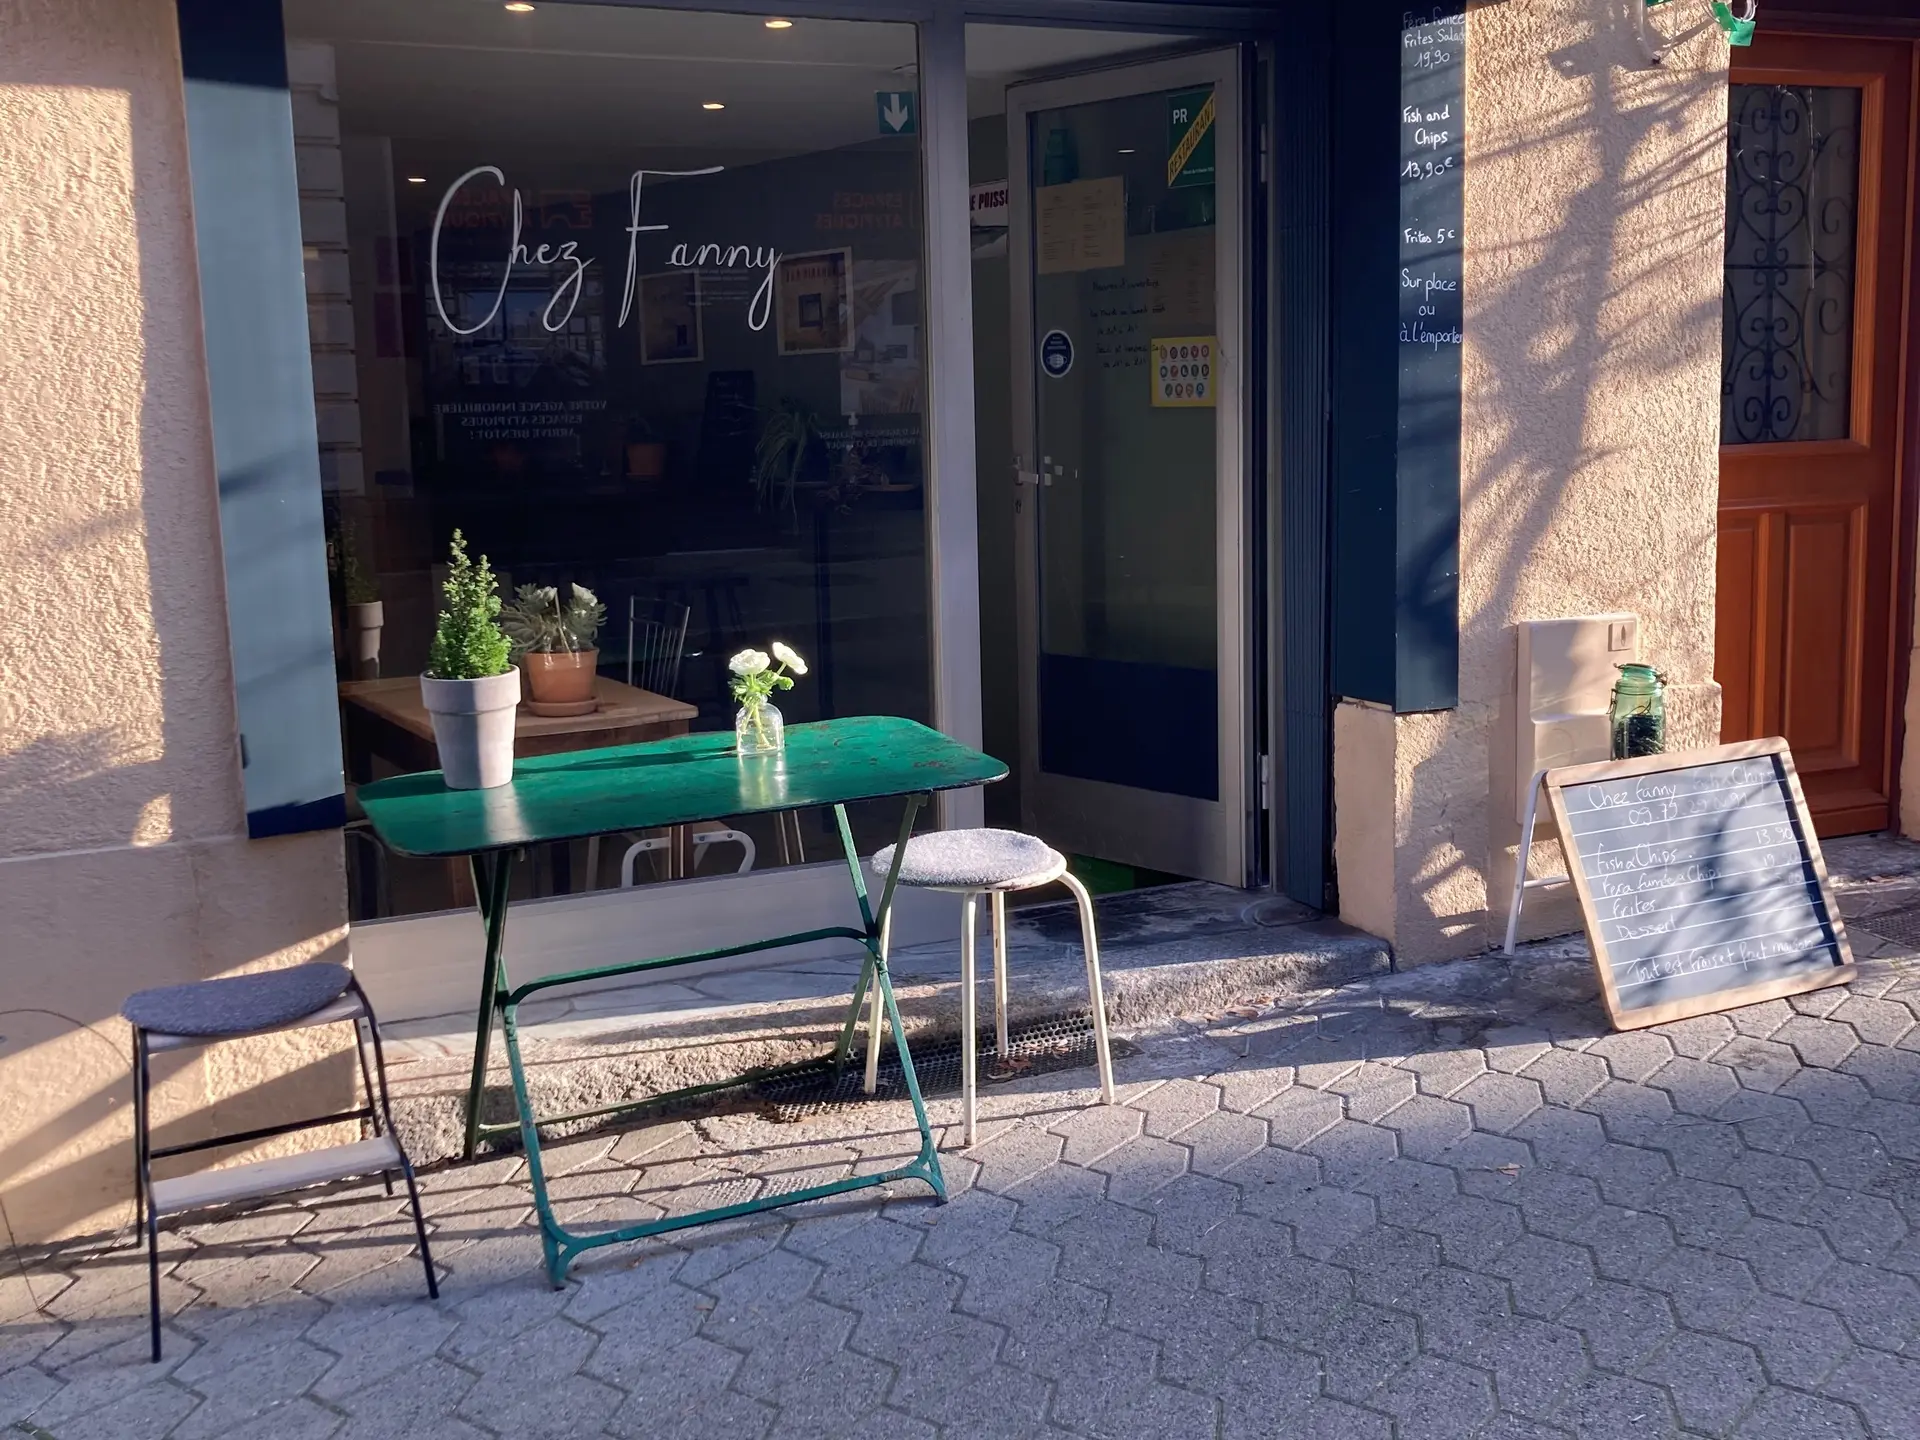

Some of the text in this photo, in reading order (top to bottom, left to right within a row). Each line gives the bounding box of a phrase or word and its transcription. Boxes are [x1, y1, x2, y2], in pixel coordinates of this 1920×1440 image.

[1404, 30, 1434, 48] Frites
[1414, 49, 1450, 69] 19,90
[1403, 104, 1450, 123] Fish and
[1415, 127, 1448, 150] Chips
[1404, 228, 1433, 243] Frites
[431, 165, 785, 335] Chez Fanny
[1402, 268, 1457, 302] Sur place
[1418, 305, 1436, 316] ou
[1588, 785, 1630, 809] Chez
[1616, 914, 1676, 938] Dessert
[1626, 957, 1660, 982] Tout
[1664, 954, 1684, 975] est
